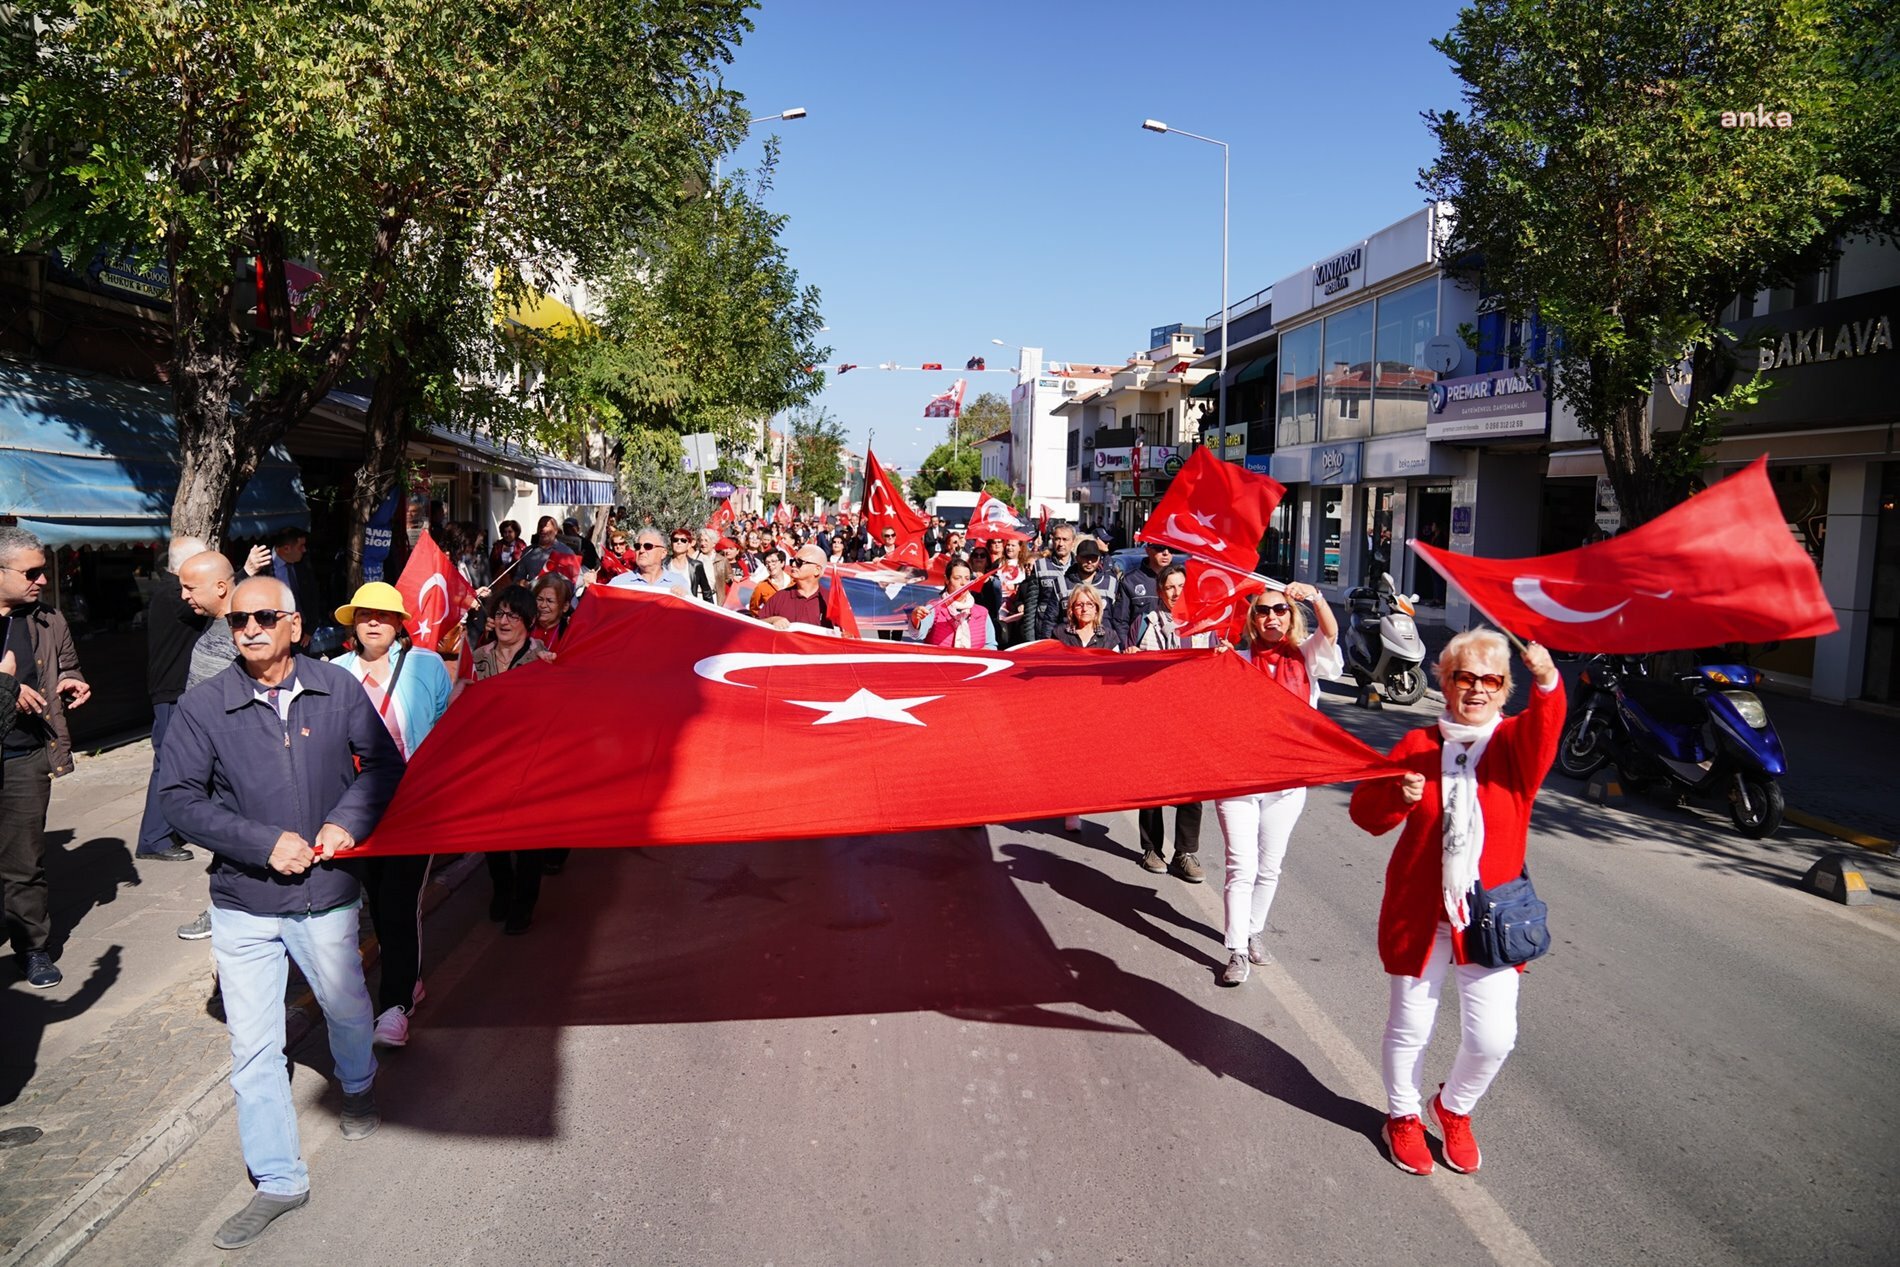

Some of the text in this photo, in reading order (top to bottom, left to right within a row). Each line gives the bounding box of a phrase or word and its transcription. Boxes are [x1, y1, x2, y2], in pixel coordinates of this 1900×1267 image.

[1315, 248, 1361, 286] KANTARCI
[107, 274, 134, 288] HUKUK
[1758, 315, 1894, 371] BAKLAVA
[1247, 463, 1267, 472] beko
[1321, 449, 1344, 469] beko
